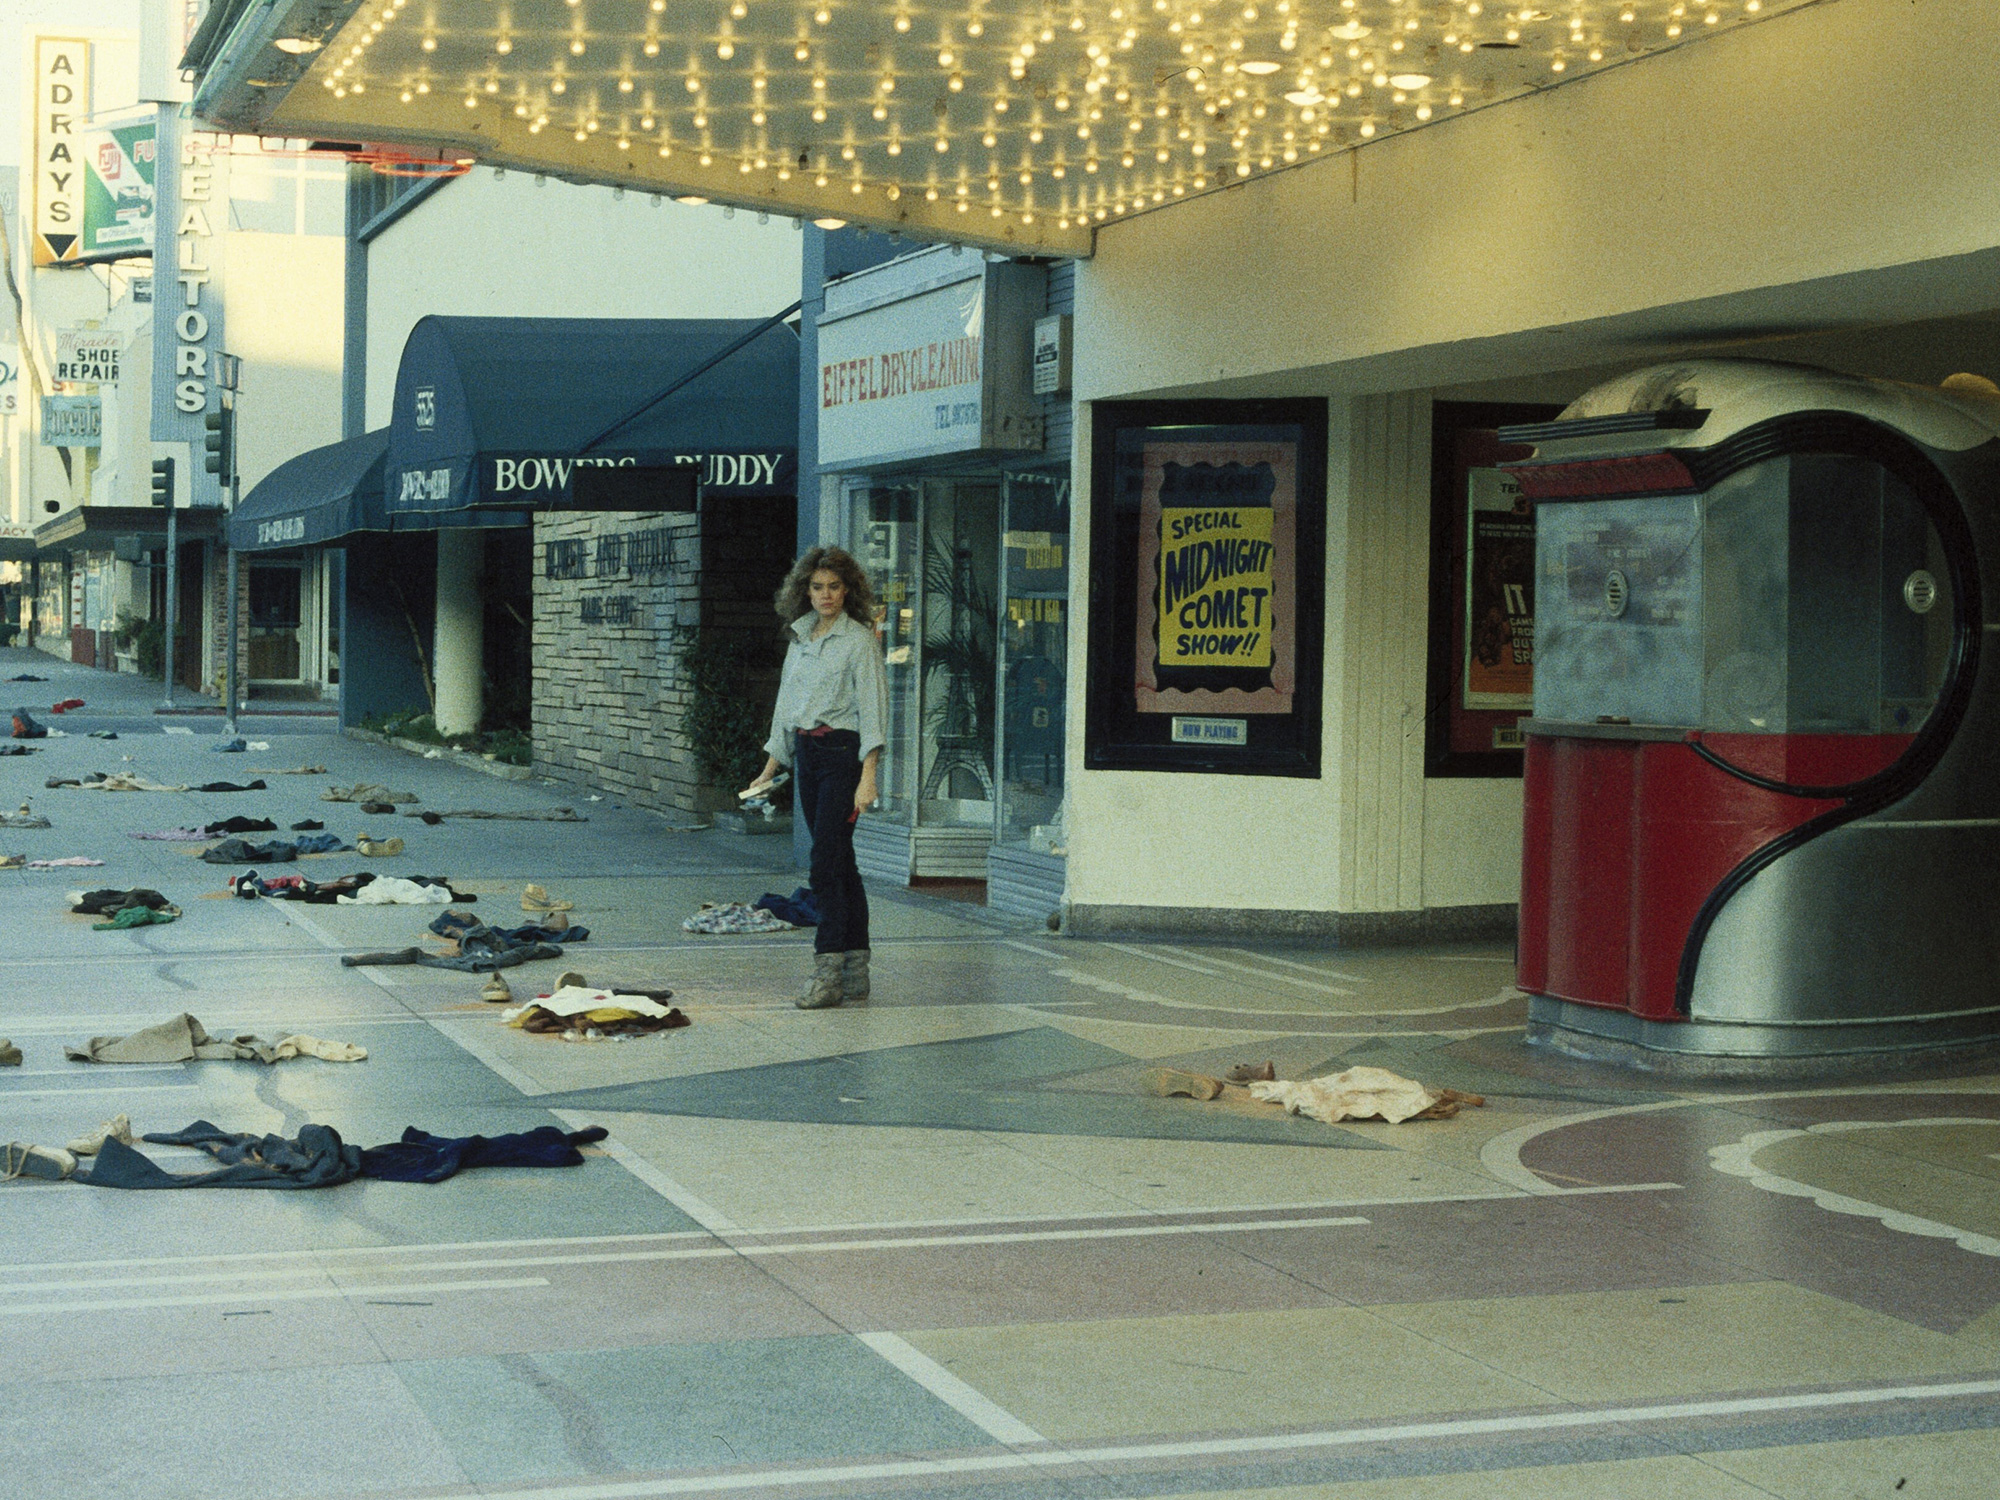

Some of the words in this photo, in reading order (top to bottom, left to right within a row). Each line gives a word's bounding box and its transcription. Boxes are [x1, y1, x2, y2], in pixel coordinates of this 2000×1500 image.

[50, 54, 73, 222] ADRAYS
[133, 139, 155, 163] FU
[176, 134, 214, 412] REALTORS
[77, 348, 119, 362] SHOE
[58, 362, 119, 380] REPAIR
[823, 356, 878, 408] EIFFEL
[495, 457, 637, 491] BOW
[674, 453, 783, 486] UDDY
[0, 527, 27, 536] ACY
[1171, 512, 1242, 539] SPECIAL
[1165, 538, 1272, 615] MIDNIGHT
[1179, 587, 1268, 629] COMET
[1503, 583, 1527, 614] IT
[1176, 632, 1260, 657] SHOW!!
[1511, 627, 1534, 637] FRO
[1514, 651, 1534, 664] SP
[1182, 724, 1201, 737] NOW
[1204, 725, 1239, 738] PLAYING
